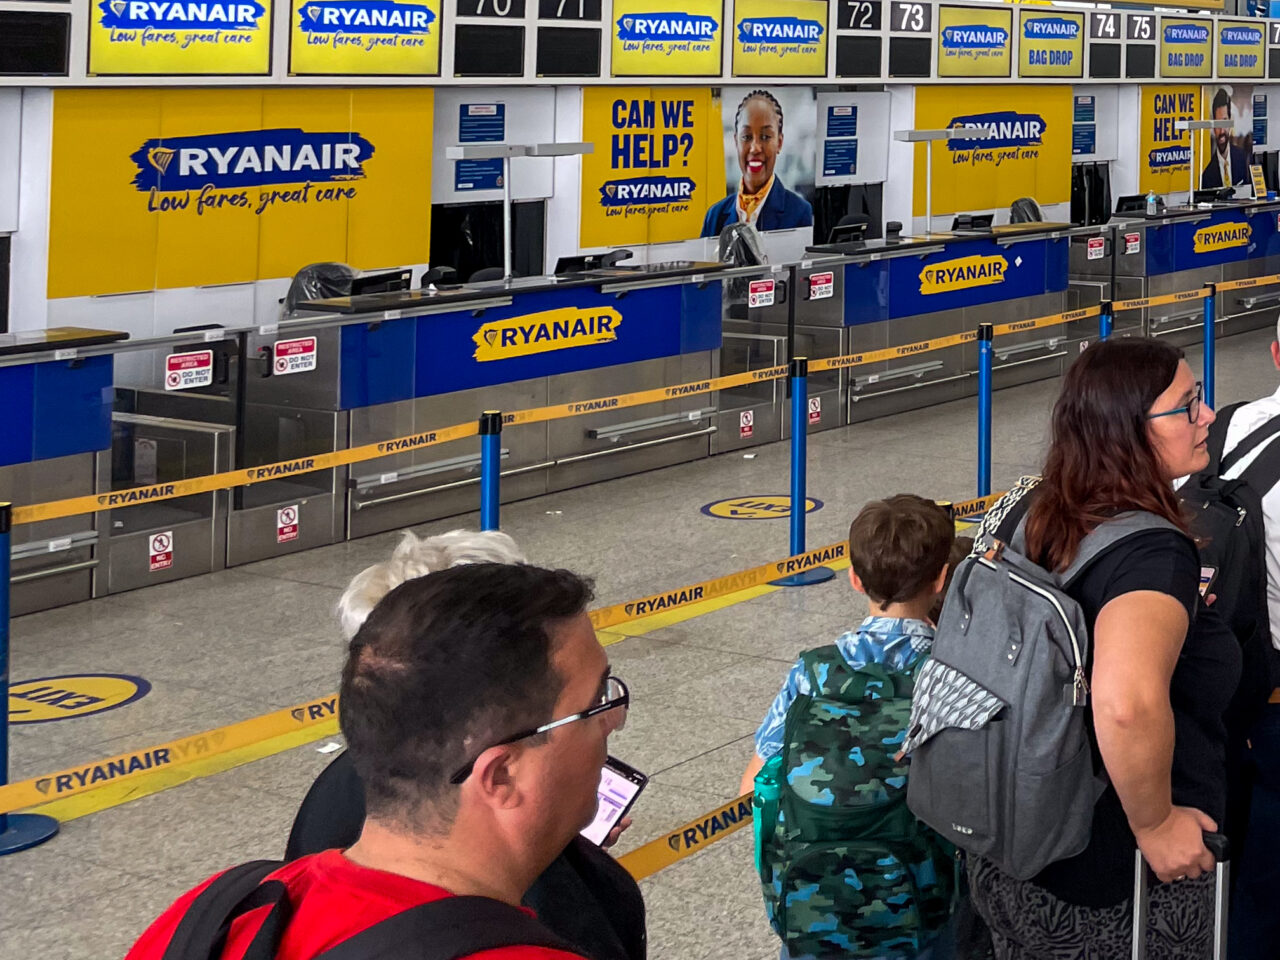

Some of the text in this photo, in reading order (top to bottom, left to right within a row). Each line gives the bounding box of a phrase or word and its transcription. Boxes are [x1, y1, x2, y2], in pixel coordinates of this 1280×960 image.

[129, 0, 256, 23] RYANAIR
[323, 7, 428, 28] RYANAIR
[847, 1, 873, 28] 72
[900, 3, 924, 31] 73
[634, 19, 713, 36] RYANAIR
[752, 23, 819, 39] RYANAIR
[1034, 21, 1077, 35] RYANAIR
[1096, 14, 1115, 37] 74
[1133, 16, 1151, 39] 75
[1172, 28, 1207, 40] RYANAIR
[110, 25, 252, 49] Low fares, great care
[307, 29, 425, 52] Low fares, great care
[953, 30, 1005, 44] RYANAIR
[1227, 30, 1260, 41] RYANAIR
[622, 37, 711, 55] Low fares, great care
[742, 41, 758, 53] Low
[1029, 50, 1073, 66] BAG DROP
[1168, 53, 1204, 67] BAG DROP
[1224, 54, 1258, 68] BAG DROP
[1154, 93, 1195, 115] CAN WE
[611, 98, 695, 130] CAN WE
[179, 142, 361, 178] RYANAIR
[611, 133, 694, 170] HELP?
[952, 148, 970, 165] Low
[147, 180, 358, 216] Low fares, great care
[617, 181, 690, 200] RYANAIR
[605, 205, 623, 217] Low
[671, 204, 689, 214] care
[1203, 226, 1249, 246] RYANAIR
[935, 261, 1003, 285] RYANAIR
[500, 314, 613, 348] RYANAIR
[278, 340, 314, 350] RESTRICTED
[901, 342, 930, 355] RYANAIR
[169, 354, 209, 364] RESTRICTED
[289, 354, 315, 364] DO NOT
[290, 361, 313, 370] ENTER
[830, 355, 863, 367] RYANAIR
[182, 368, 211, 378] DO NOT
[184, 375, 209, 385] ENTER
[758, 366, 789, 380] RYANAI
[671, 381, 710, 396] RYANAIR
[574, 398, 618, 413] RYANAIR
[385, 432, 437, 453] RYANAIR
[256, 458, 315, 479] RYANAIR
[108, 484, 174, 506] RYANAIR
[953, 500, 986, 517] ANAIR
[786, 545, 845, 574] RYANAIR
[635, 585, 704, 616] RYANAIR
[9, 686, 106, 710] EXIT
[55, 747, 172, 794] RYANAIR
[683, 796, 753, 850] RYANA
